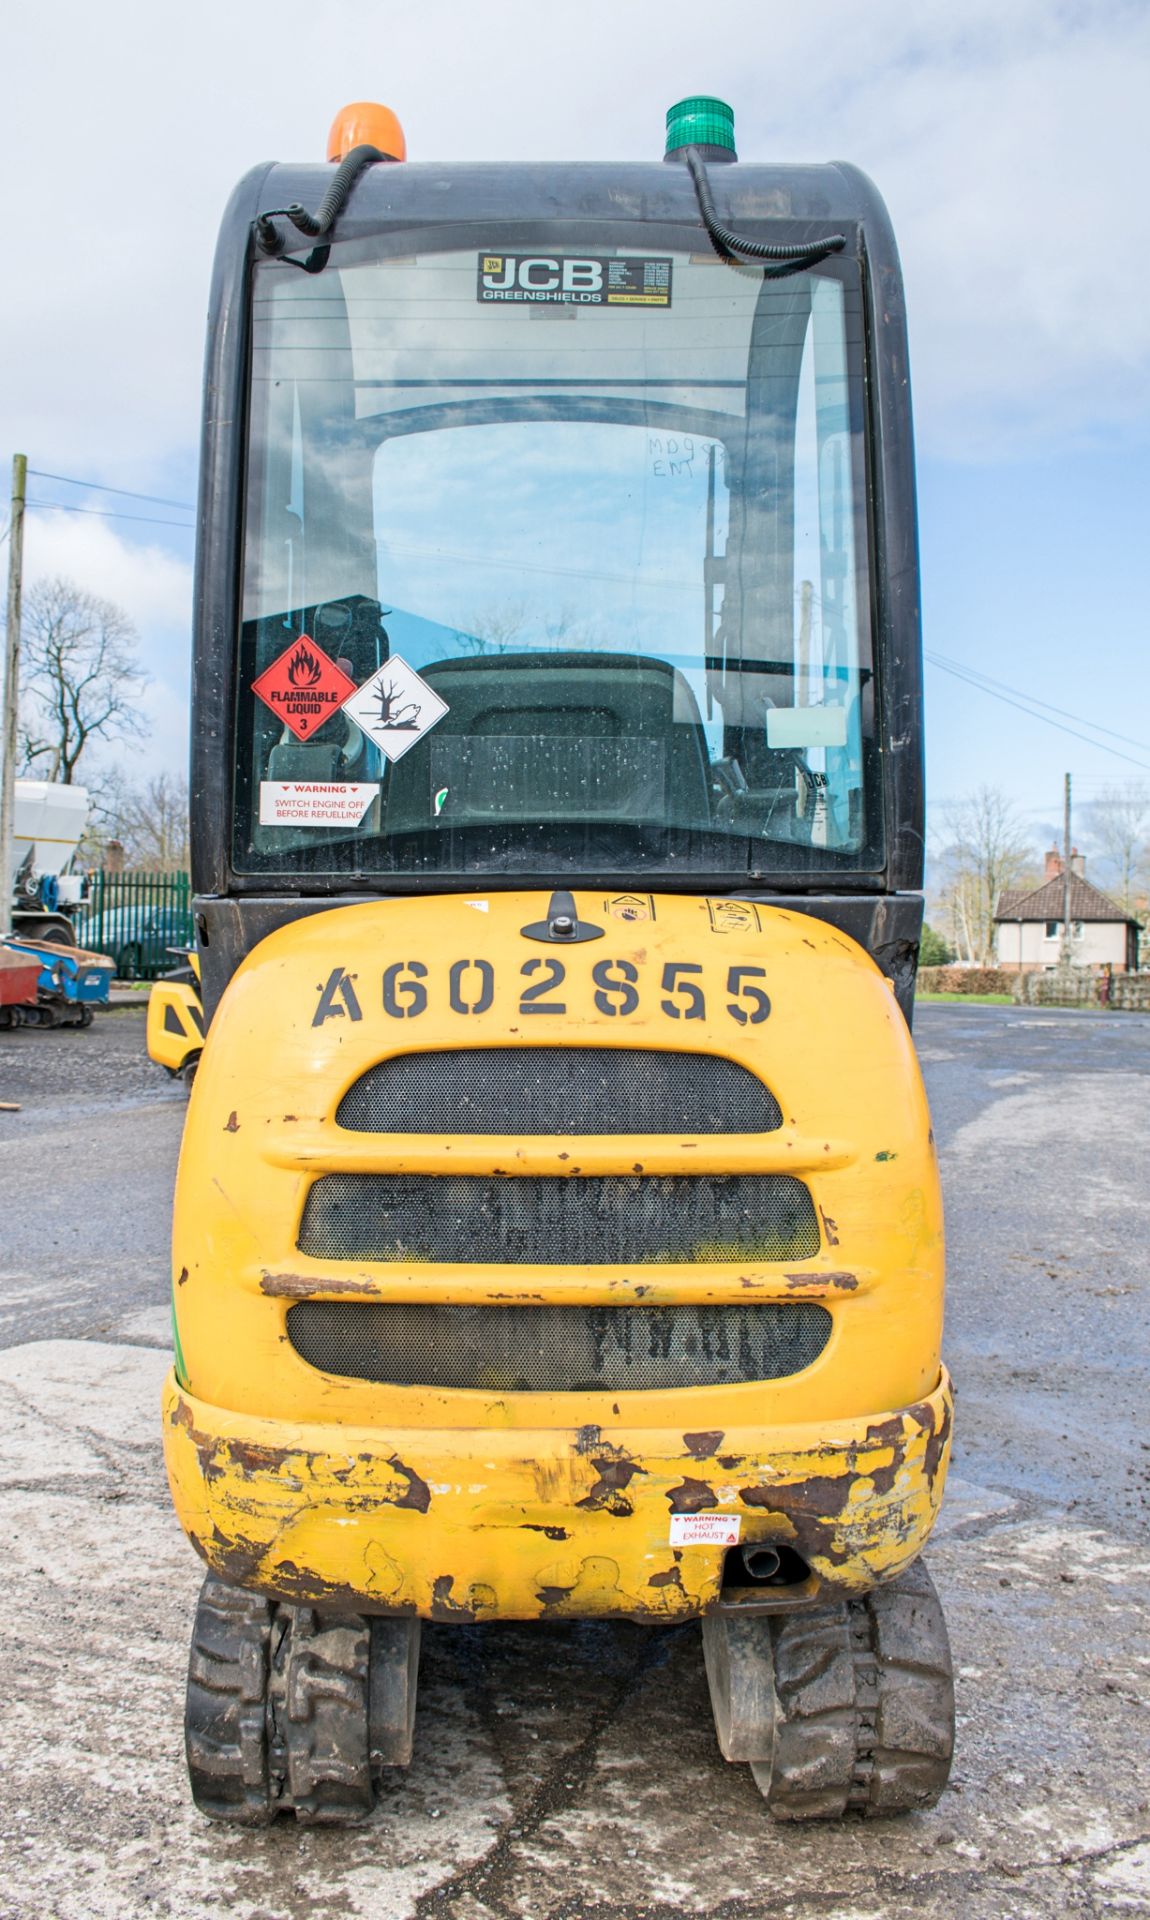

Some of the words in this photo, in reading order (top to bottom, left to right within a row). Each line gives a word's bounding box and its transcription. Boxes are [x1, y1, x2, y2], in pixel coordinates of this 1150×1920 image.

[483, 257, 603, 292] JCB
[483, 290, 602, 303] GREENSHIELDS
[271, 691, 338, 703] FLAMMABLE
[286, 703, 321, 715] LIQUID
[299, 719, 308, 730] 3
[807, 772, 828, 789] JCB
[294, 785, 347, 794] WARNING
[275, 799, 311, 808] SWITCH
[313, 800, 346, 809] ENGINE
[348, 801, 365, 809] OFF
[276, 810, 309, 818] BEFORE
[311, 811, 363, 820] REFUELLING
[311, 958, 772, 1028] A602855
[683, 1531, 725, 1540] EXHAUST
